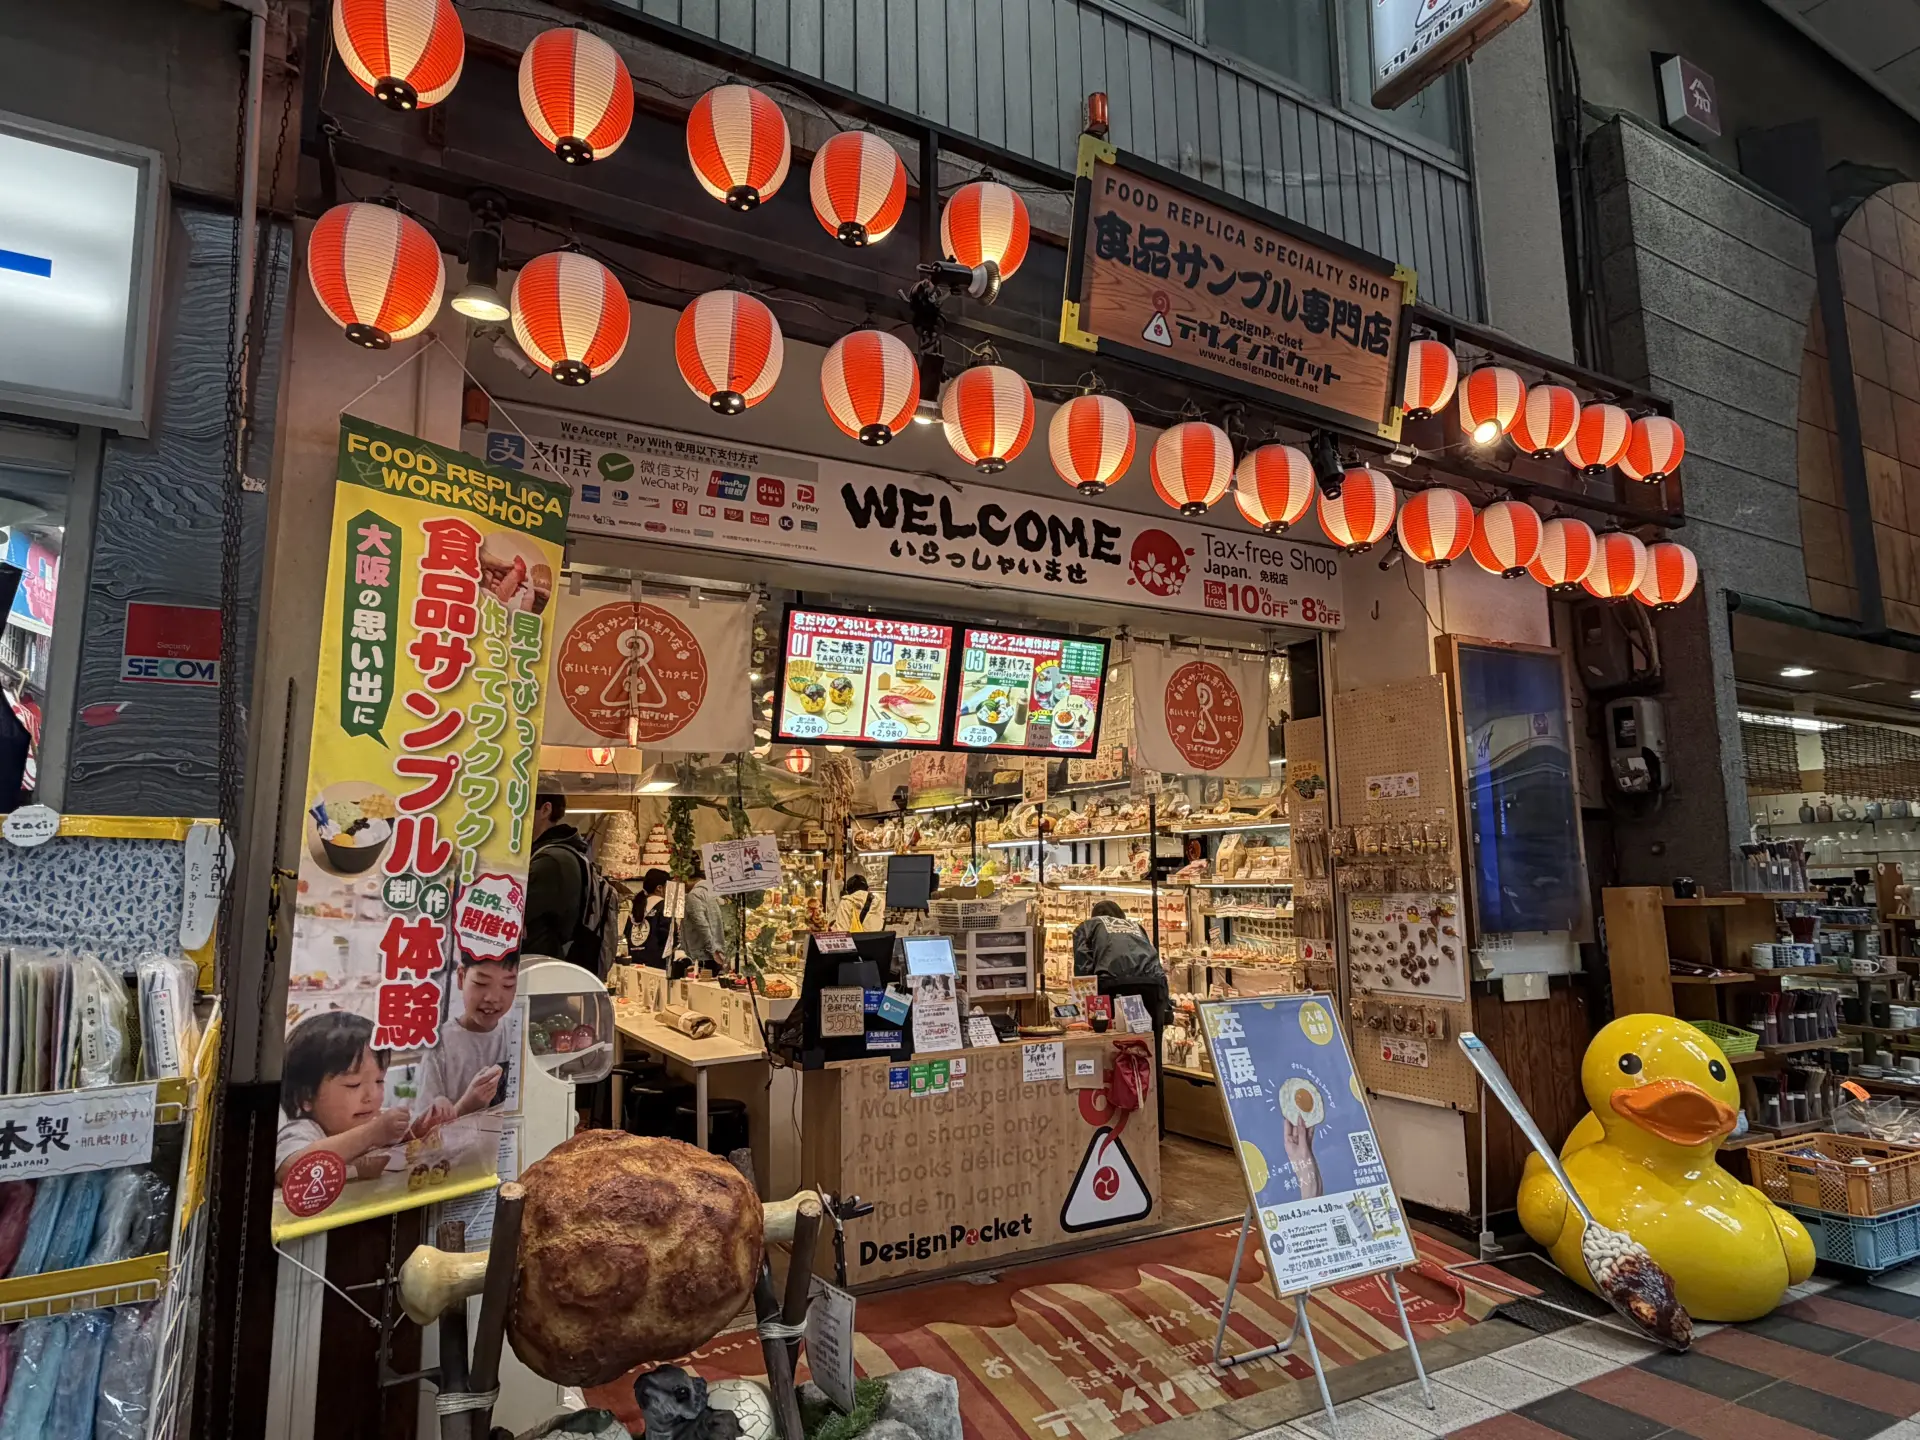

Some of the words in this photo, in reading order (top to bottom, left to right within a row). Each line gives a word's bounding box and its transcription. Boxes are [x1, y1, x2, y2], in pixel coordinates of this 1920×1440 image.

[1105, 177, 1158, 212] FOOD
[1167, 201, 1246, 248] REPLICA
[1254, 236, 1344, 285] SPECIALTY
[1349, 274, 1389, 302] SHOP
[1094, 210, 1392, 357] 食品サンプル専門店
[1220, 310, 1304, 351] DesignPocket
[1176, 313, 1341, 386] デザインポケット
[1199, 348, 1319, 394] www.designpocket.net
[561, 422, 579, 434] We
[581, 425, 617, 441] Accept
[627, 433, 646, 447] Pay
[648, 436, 672, 450] With
[530, 441, 592, 469] 支付宝
[347, 432, 438, 476] FOOD
[446, 462, 564, 519] REPLICA
[640, 459, 699, 482] 微信支付
[381, 466, 543, 530] WORKSHOP
[641, 476, 679, 491] WeChat
[682, 482, 699, 496] Pay
[792, 501, 820, 514] PayPay
[841, 482, 1122, 565] WELCOME
[889, 539, 1088, 585] いらっしゃいませ
[1201, 532, 1284, 567] Tax-free
[1290, 548, 1338, 580] Shop
[1203, 558, 1252, 580] Japan.
[1260, 570, 1288, 586] 免税店
[1206, 582, 1223, 596] Tax
[1205, 595, 1227, 609] free
[1261, 602, 1289, 618] OFF
[1318, 611, 1341, 626] OFF
[348, 523, 392, 725] 大阪の思い出に
[157, 641, 191, 653] Security
[791, 632, 809, 656] 01
[816, 638, 866, 656] たこ焼き
[872, 639, 893, 664] 02
[970, 631, 1060, 652] 食品サンプル制作体験
[816, 653, 865, 665] TAKOYAKI
[900, 647, 940, 662] お寿司
[906, 661, 932, 671] SUSHI
[965, 649, 984, 671] 03
[988, 655, 1031, 671] 抹茶パフェ
[127, 658, 215, 680] SECOM
[564, 662, 612, 676] おいしそう!
[657, 668, 699, 681] をカタチに
[455, 595, 508, 886] 作ってワクワク!
[508, 610, 543, 852] 見てびっくり!
[711, 852, 726, 864] OK
[744, 846, 758, 858] NG
[468, 888, 512, 914] 店内にて
[460, 906, 519, 942] 開催中
[822, 994, 840, 1003] TAX
[840, 993, 861, 1003] FREE
[1214, 1010, 1258, 1085] 卒展
[1234, 1085, 1262, 1099] 第13回
[860, 1131, 896, 1152] Put
[905, 1132, 918, 1147] a
[927, 1119, 996, 1146] shape
[1004, 1113, 1051, 1136] onto
[890, 1158, 952, 1186] looks
[859, 1213, 1033, 1267] DesignPocket
